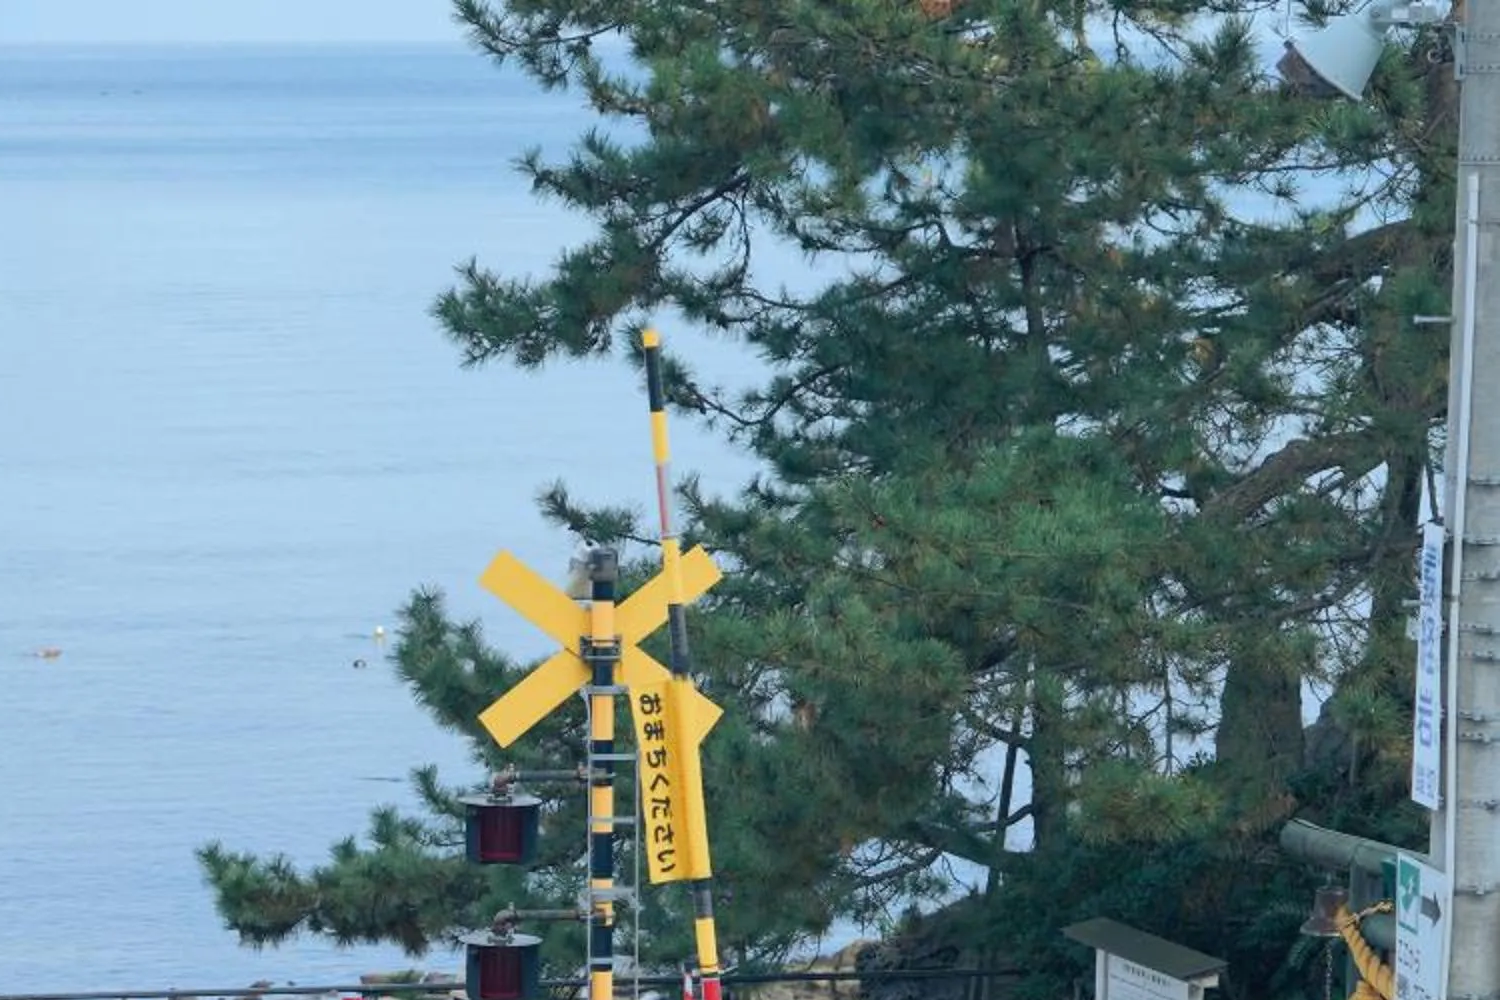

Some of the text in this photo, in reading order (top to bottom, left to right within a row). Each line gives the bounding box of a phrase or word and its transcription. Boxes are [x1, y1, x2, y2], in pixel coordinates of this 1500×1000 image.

[640, 693, 676, 872] おまちください
